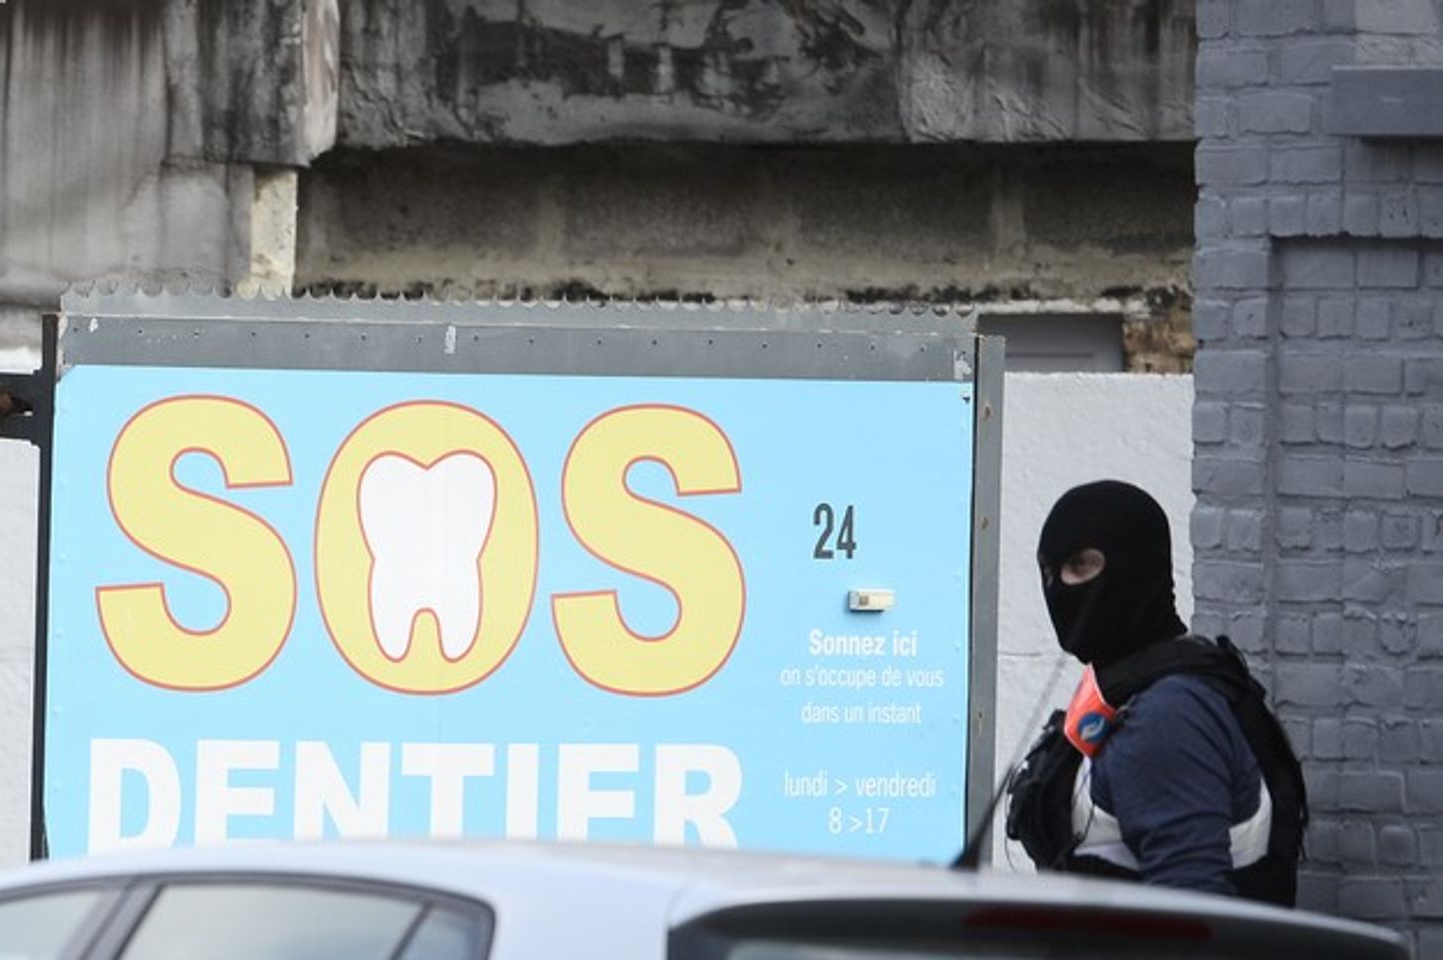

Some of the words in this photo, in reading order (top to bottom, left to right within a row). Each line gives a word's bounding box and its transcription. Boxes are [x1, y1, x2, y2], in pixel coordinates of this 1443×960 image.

[813, 502, 856, 559] 24
[95, 393, 746, 698] SOS
[808, 629, 885, 657] Sonnez
[893, 631, 918, 657] ici
[779, 668, 801, 685] on
[805, 665, 877, 690] s'occupe
[881, 666, 903, 686] de
[906, 672, 945, 688] vous
[801, 702, 840, 723] dans
[844, 707, 864, 723] un
[867, 703, 922, 724] instant
[90, 739, 743, 852] DENTIER
[784, 771, 829, 796] lundi
[855, 771, 937, 797] vendredi
